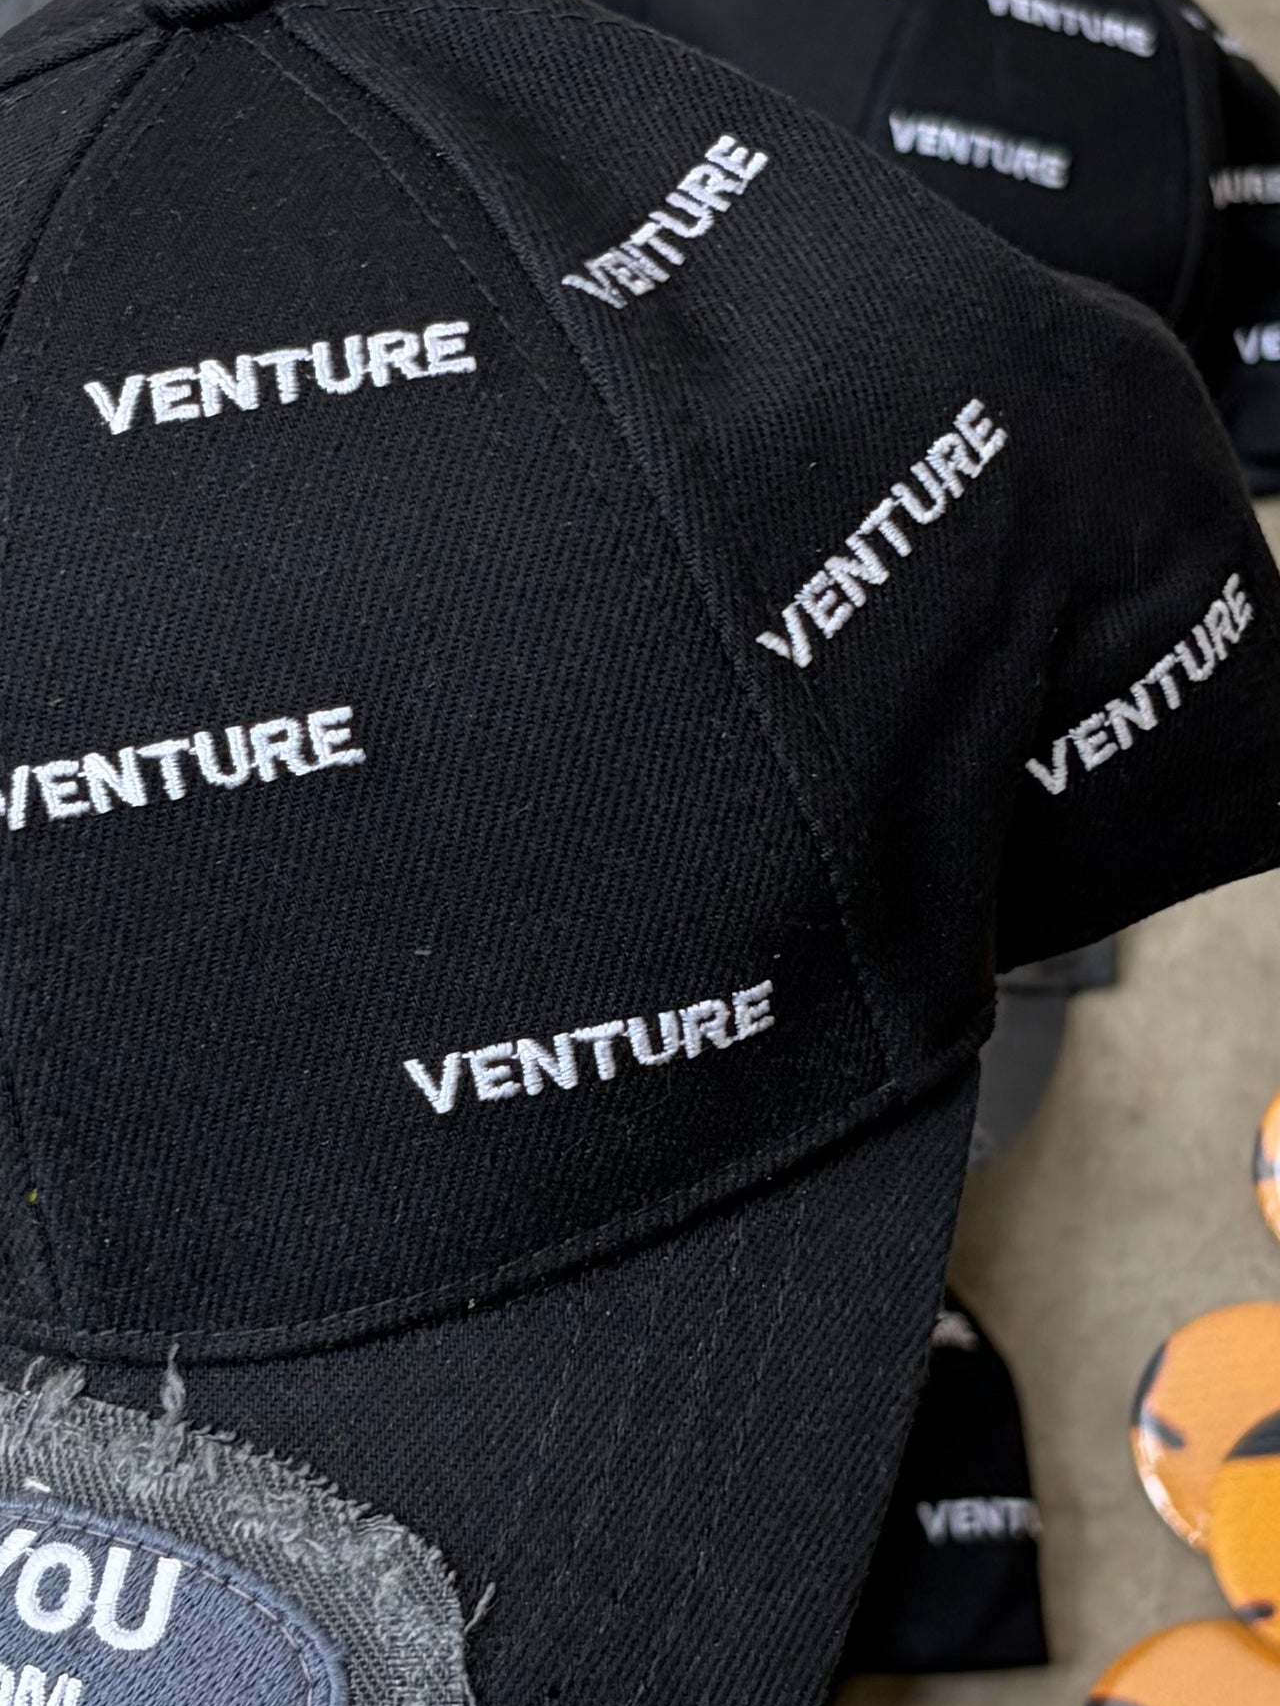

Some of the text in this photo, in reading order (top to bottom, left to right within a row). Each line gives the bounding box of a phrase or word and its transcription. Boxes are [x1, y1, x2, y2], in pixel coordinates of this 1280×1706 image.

[561, 134, 770, 309] VENTURE
[888, 113, 1071, 190] VENTURE
[83, 320, 477, 436] VENTURE
[755, 398, 1008, 668] VENTURE
[1025, 572, 1254, 796] VENTURE
[403, 979, 775, 1115] VENTURE
